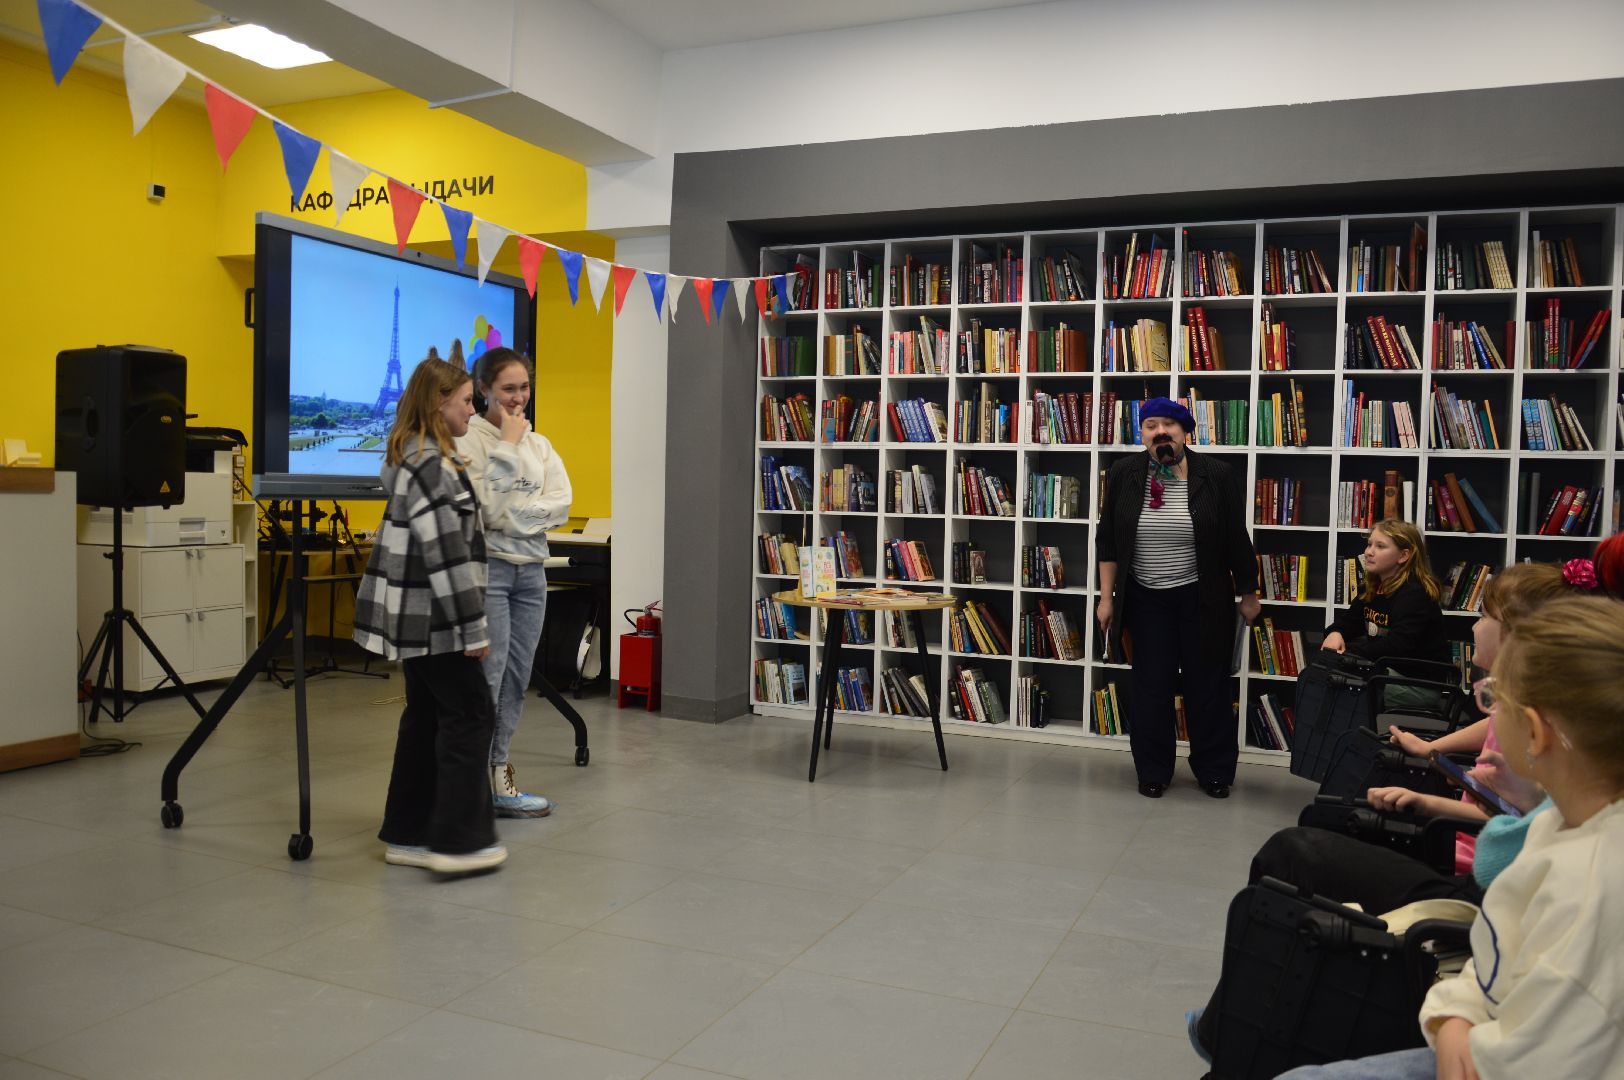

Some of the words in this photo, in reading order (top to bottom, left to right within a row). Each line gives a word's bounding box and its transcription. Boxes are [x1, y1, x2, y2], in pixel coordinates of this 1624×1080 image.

[290, 185, 390, 213] КАФДРА
[400, 175, 494, 204] ДАЧИ
[1363, 606, 1389, 626] GUCCI
